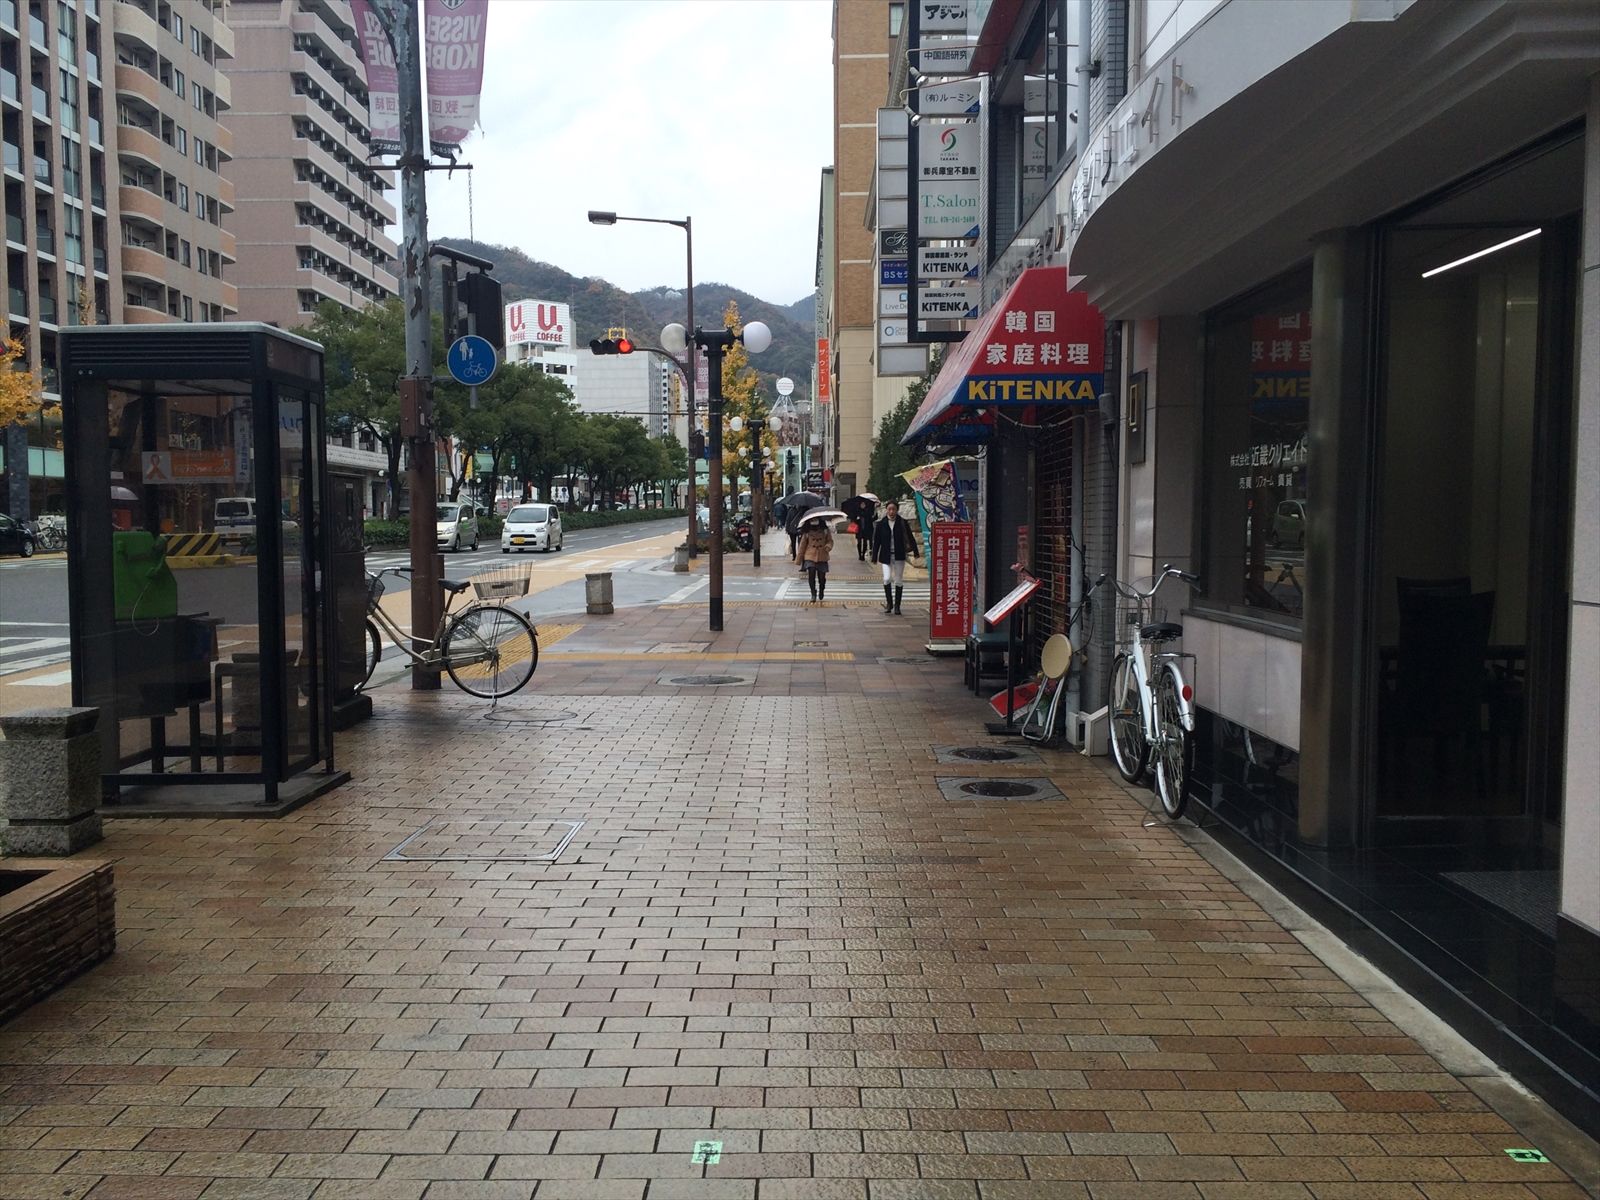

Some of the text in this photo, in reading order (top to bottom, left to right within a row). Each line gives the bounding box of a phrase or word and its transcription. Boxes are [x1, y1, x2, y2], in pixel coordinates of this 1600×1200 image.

[921, 194, 976, 208] T.Salon
[1005, 310, 1056, 333] 韓国
[537, 331, 563, 342] COFFEE
[986, 342, 1090, 365] 家庭料理
[947, 536, 960, 615] 中国語研究会
